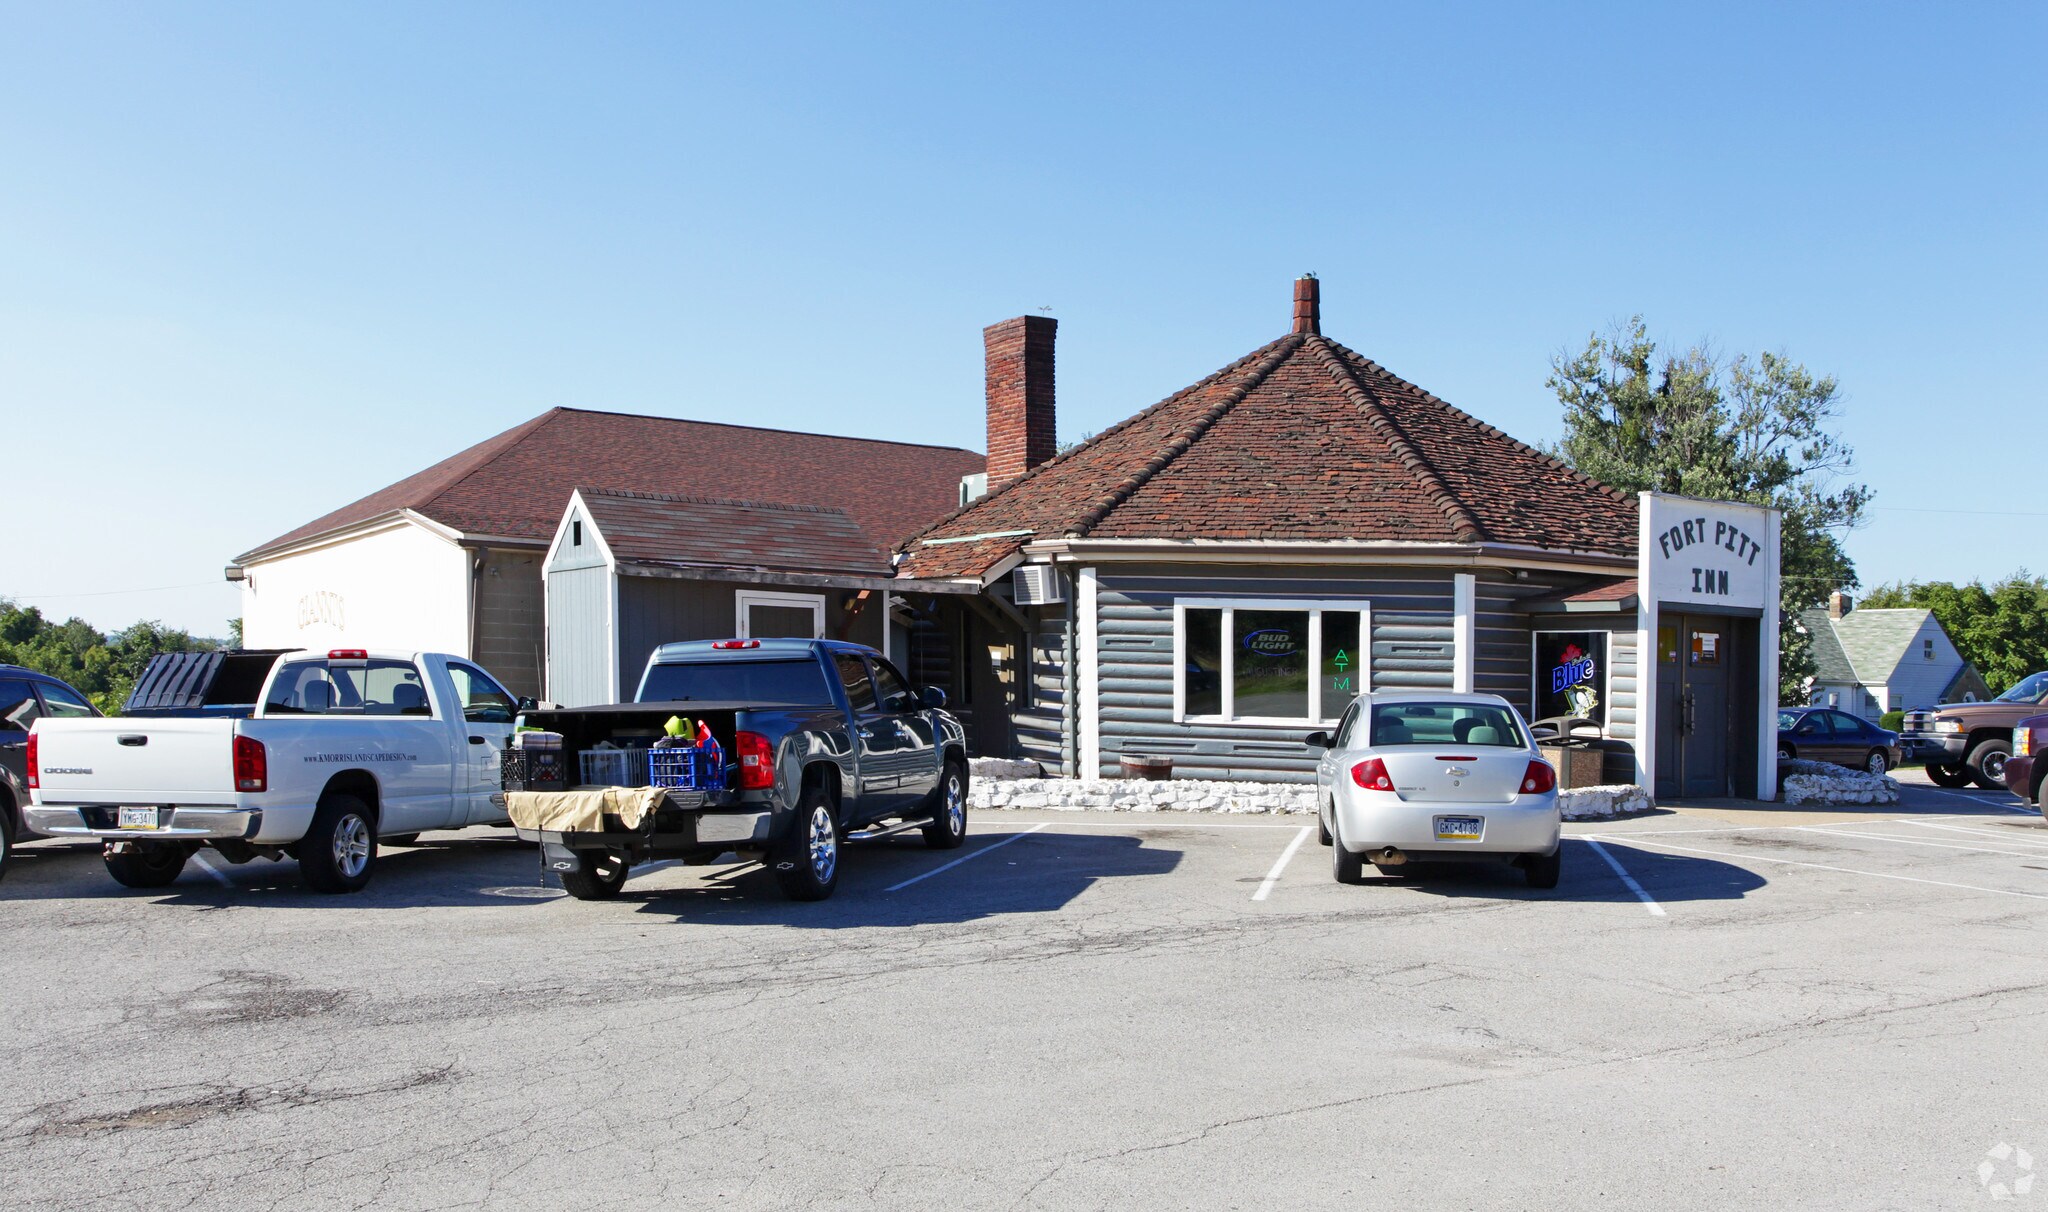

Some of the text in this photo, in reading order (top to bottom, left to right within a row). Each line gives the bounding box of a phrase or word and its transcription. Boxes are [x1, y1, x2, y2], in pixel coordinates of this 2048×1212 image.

[1659, 518, 1760, 566] FORT PITT
[1692, 568, 1728, 595] INN
[1258, 634, 1289, 642] BUD
[1333, 649, 1349, 690] ATM
[1552, 659, 1594, 693] Blue
